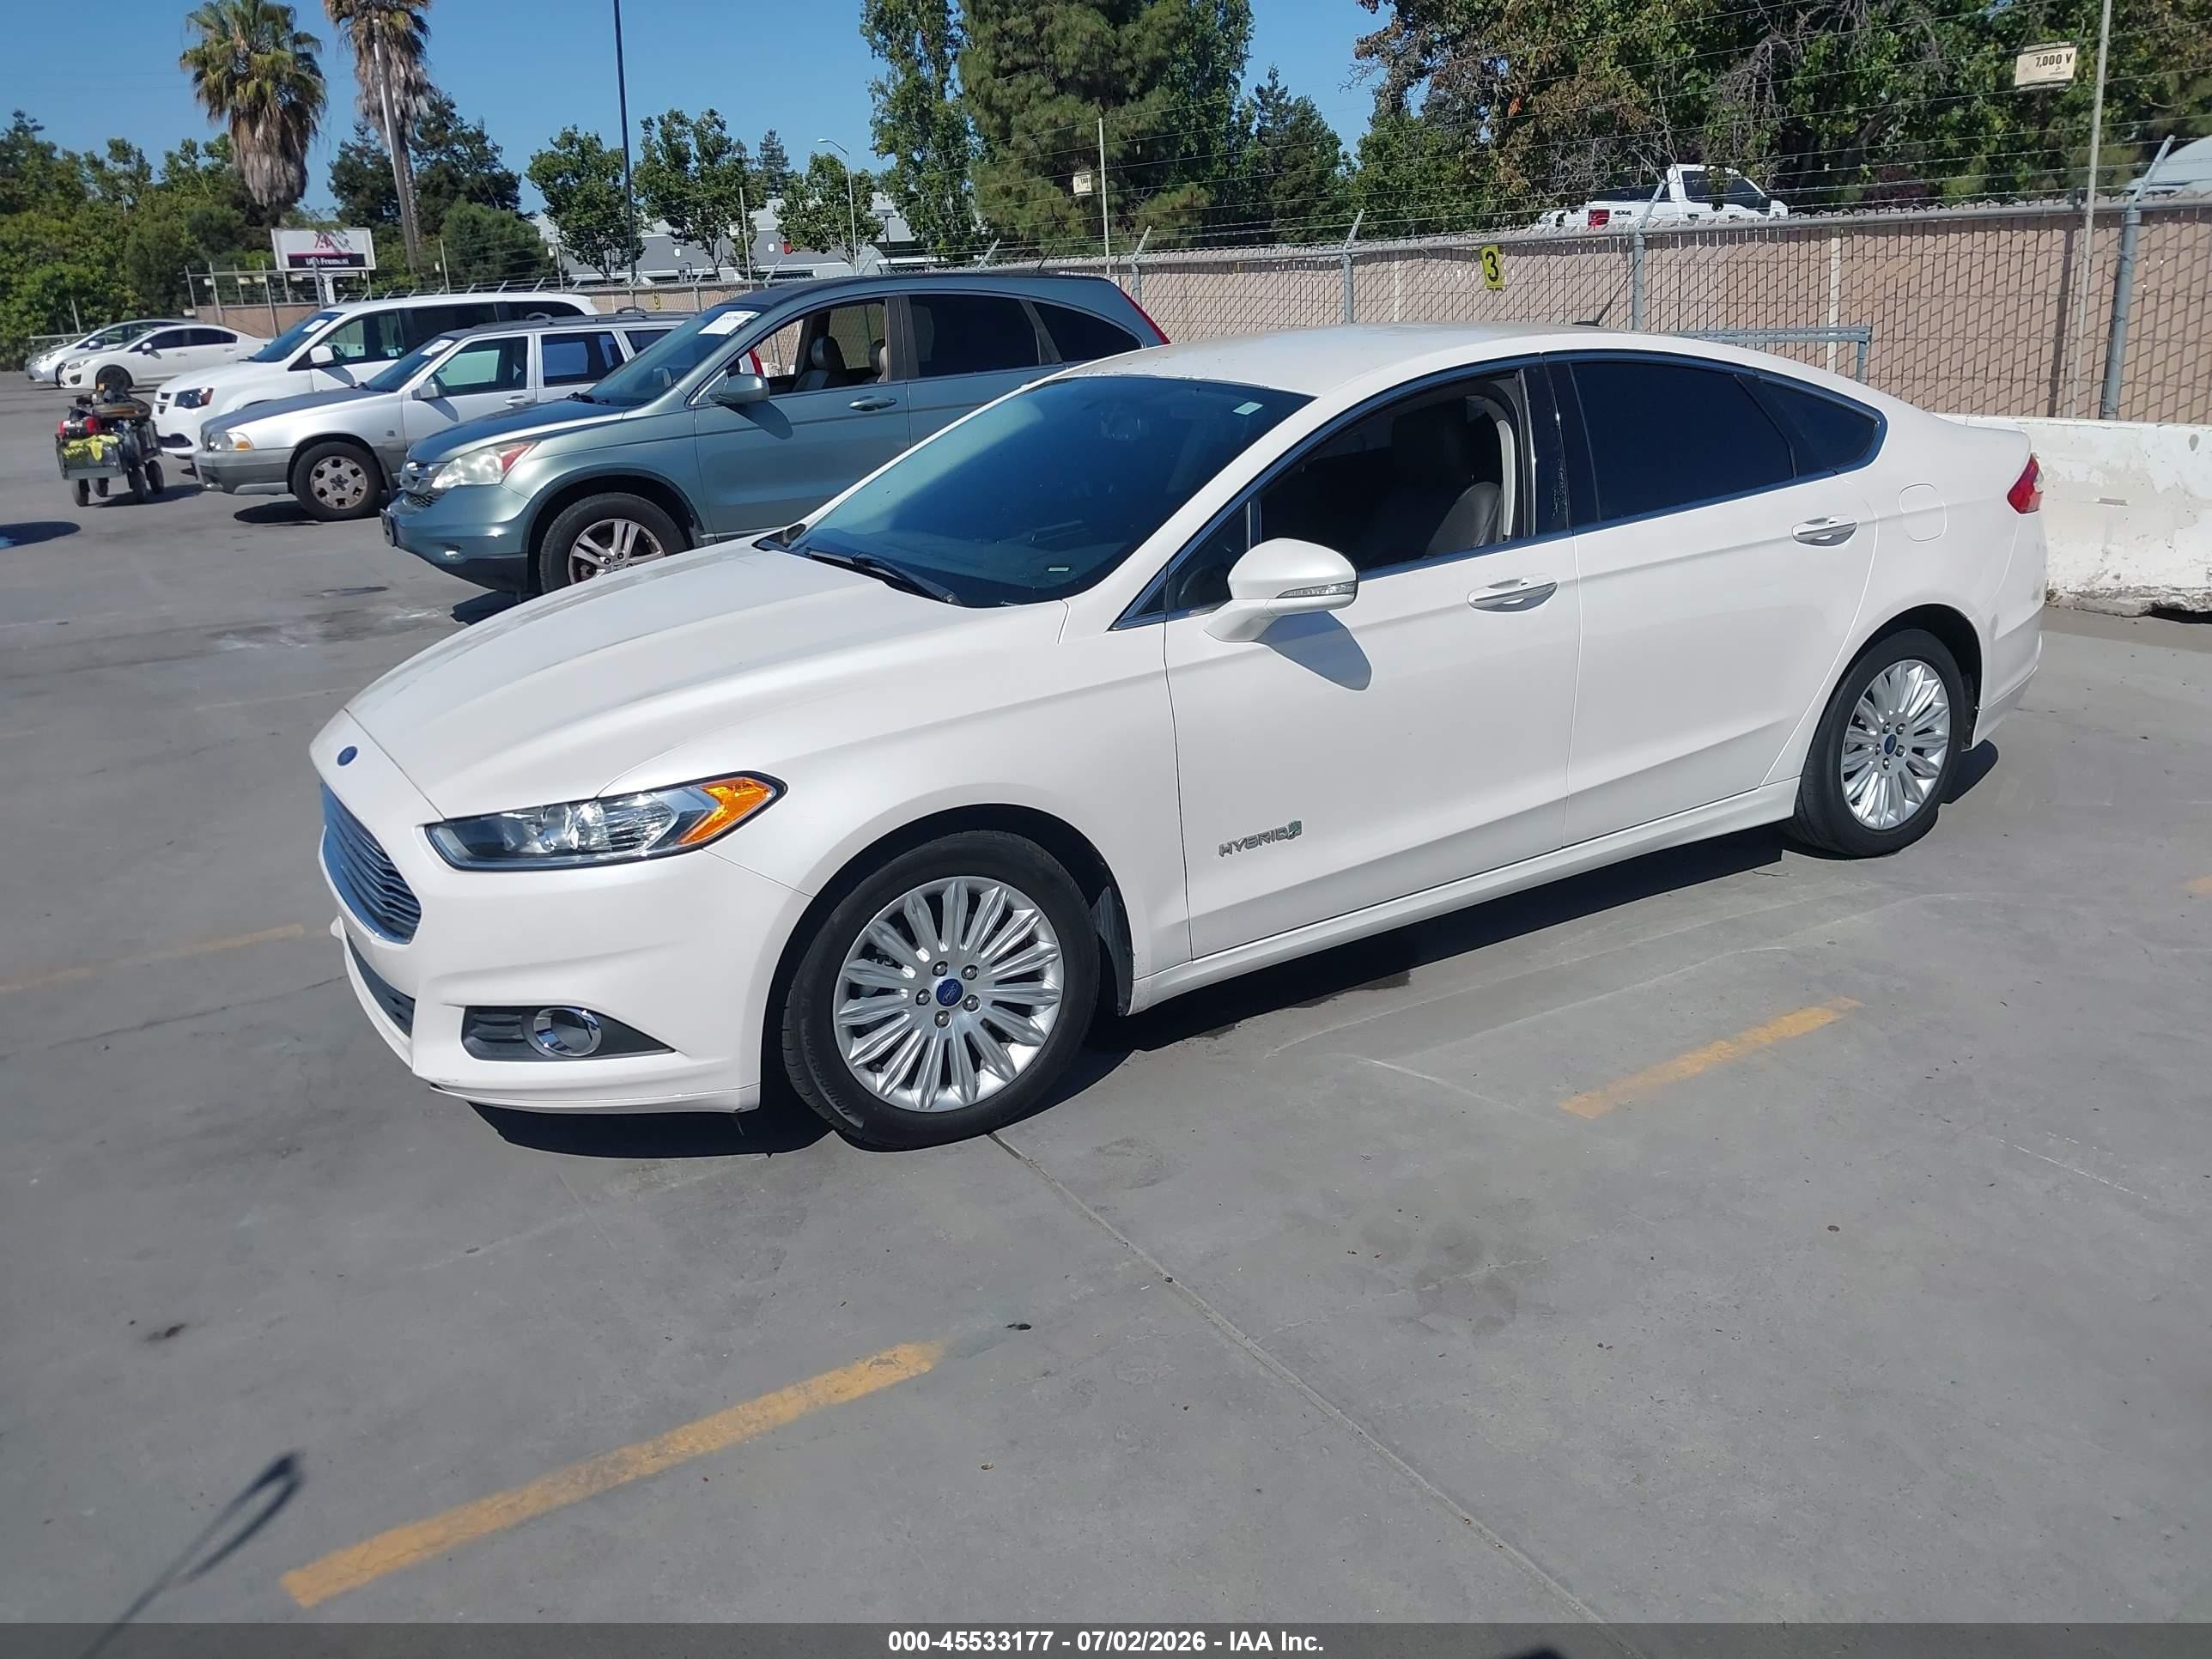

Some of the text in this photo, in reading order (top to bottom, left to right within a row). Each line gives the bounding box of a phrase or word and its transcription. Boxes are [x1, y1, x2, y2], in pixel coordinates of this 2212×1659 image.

[2035, 52, 2073, 69] 7,000 V
[1485, 250, 1499, 283] 3
[1218, 826, 1289, 857] HYBRID
